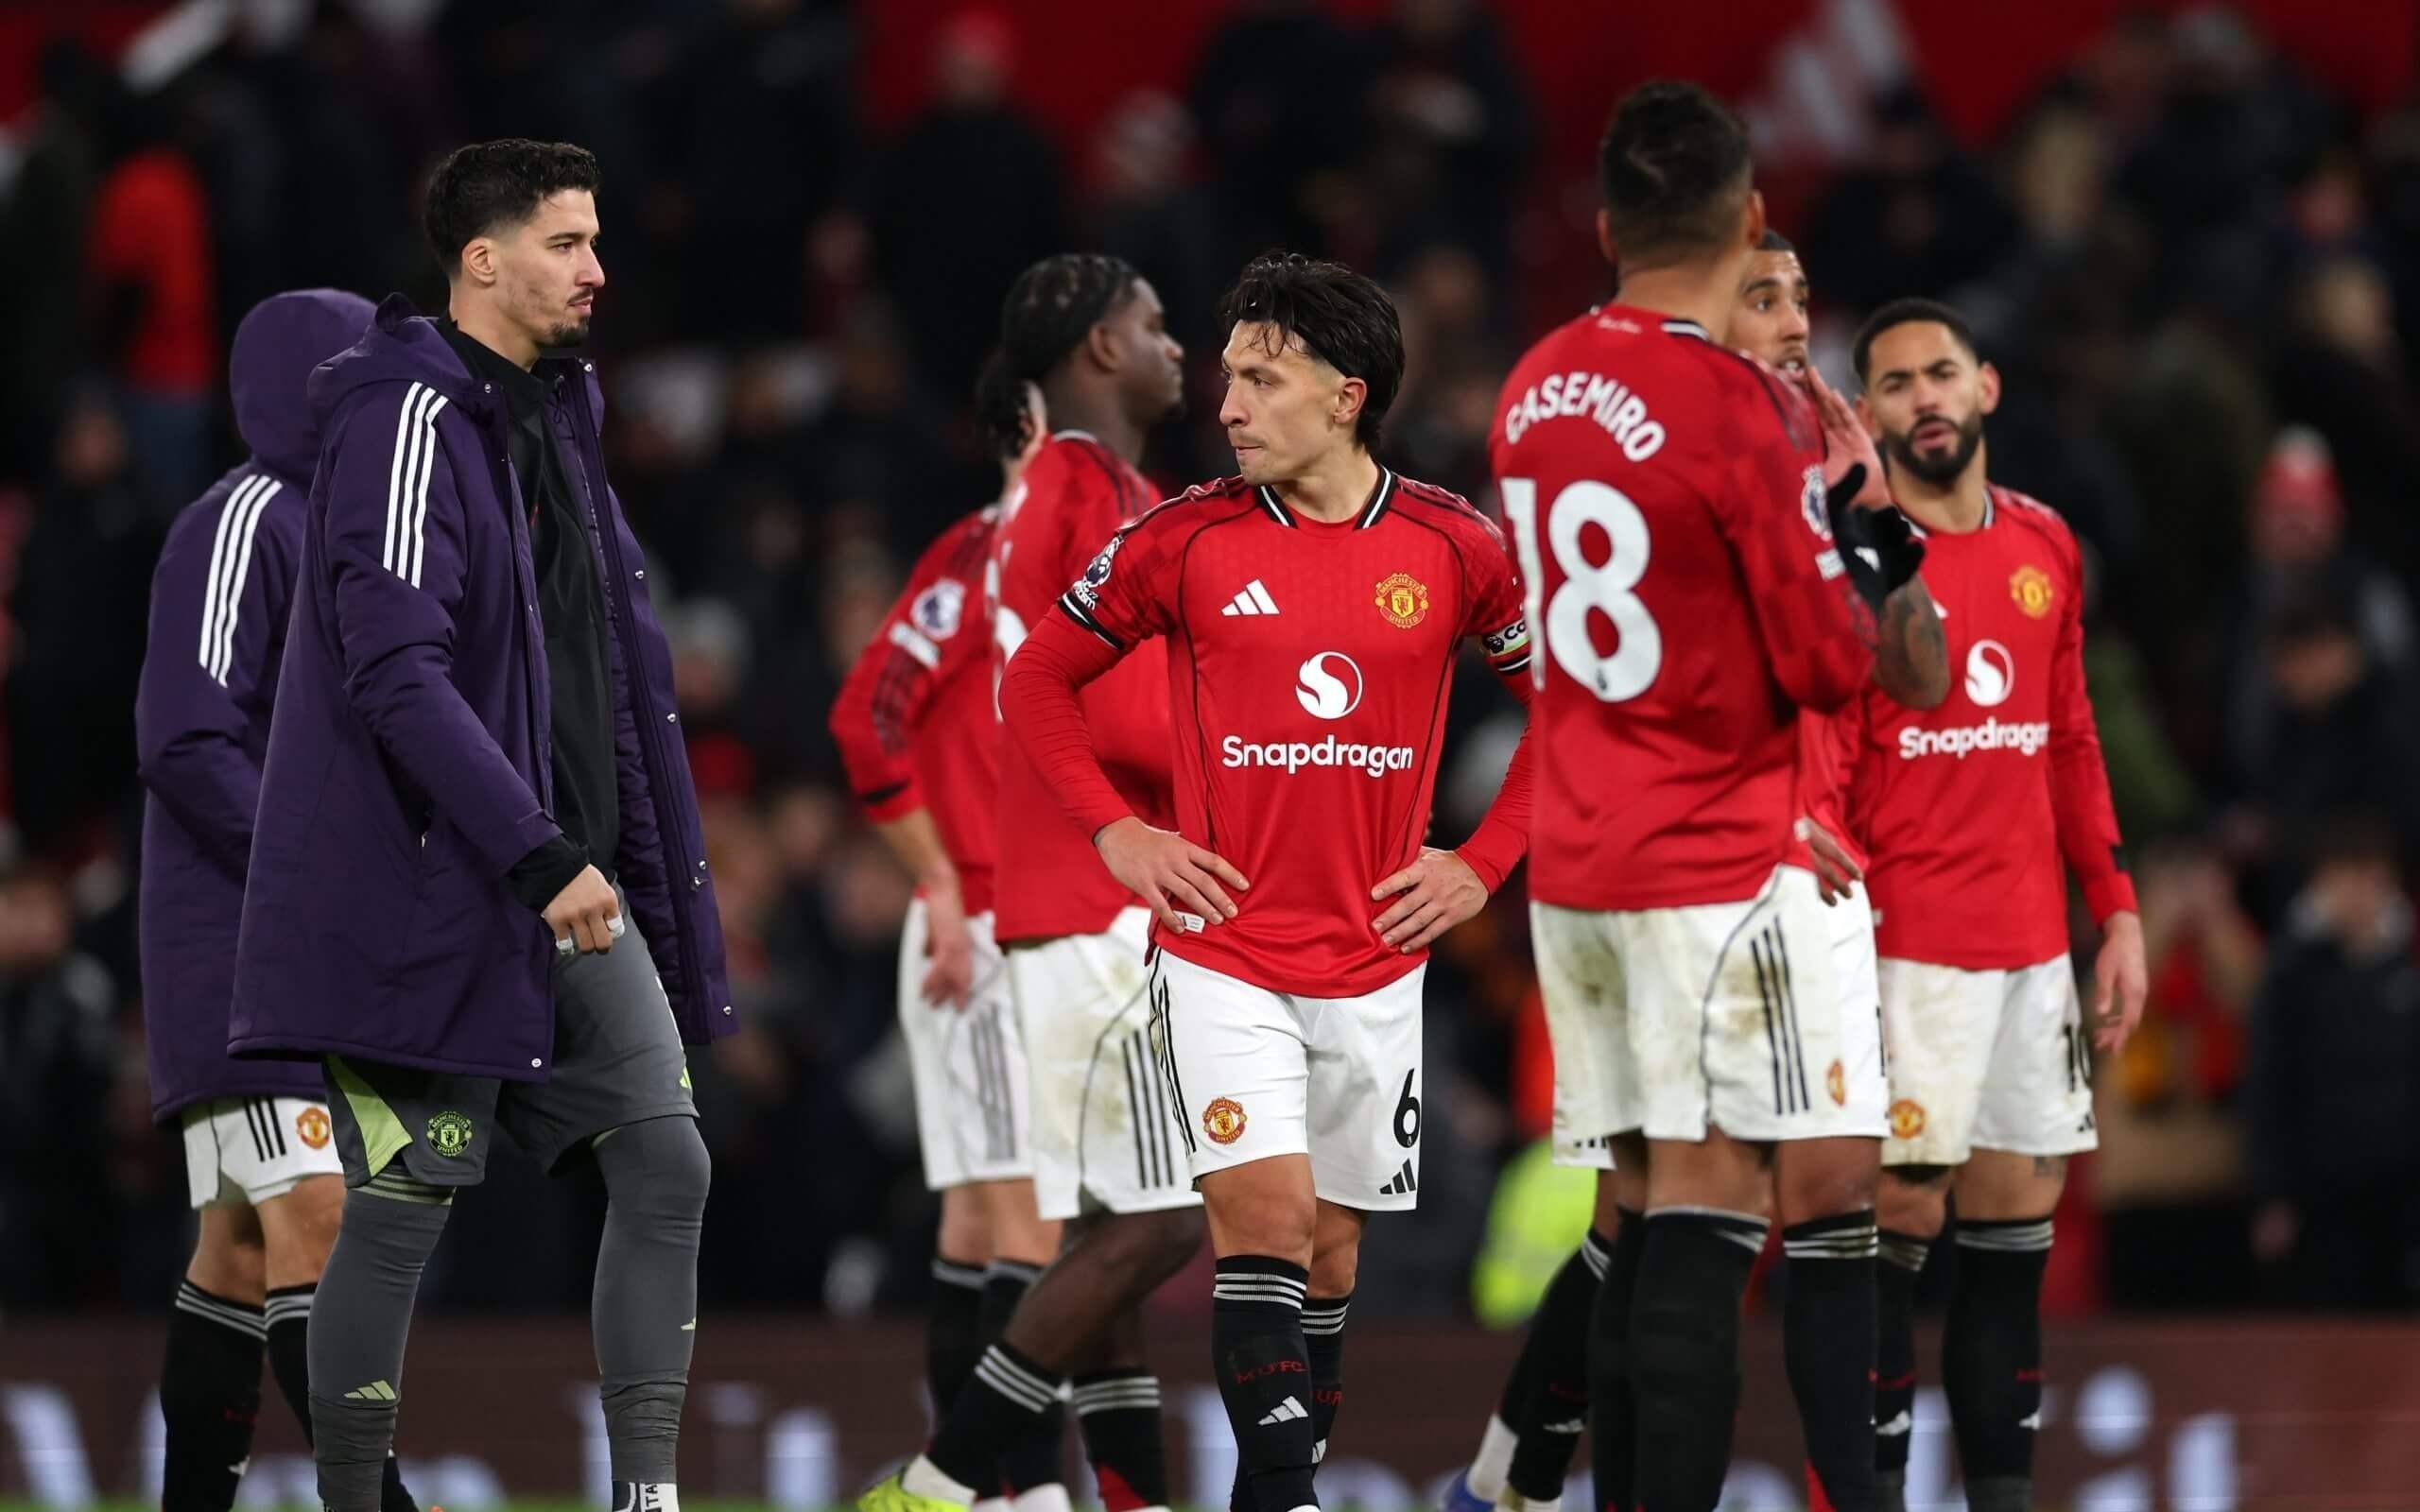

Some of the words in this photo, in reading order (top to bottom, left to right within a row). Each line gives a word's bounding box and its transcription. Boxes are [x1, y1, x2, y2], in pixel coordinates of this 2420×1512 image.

[1505, 371, 1666, 462] CASEMIRO
[1500, 476, 1664, 703] 18
[1222, 734, 1413, 778] Snapdragon
[1393, 1067, 1421, 1148] 6
